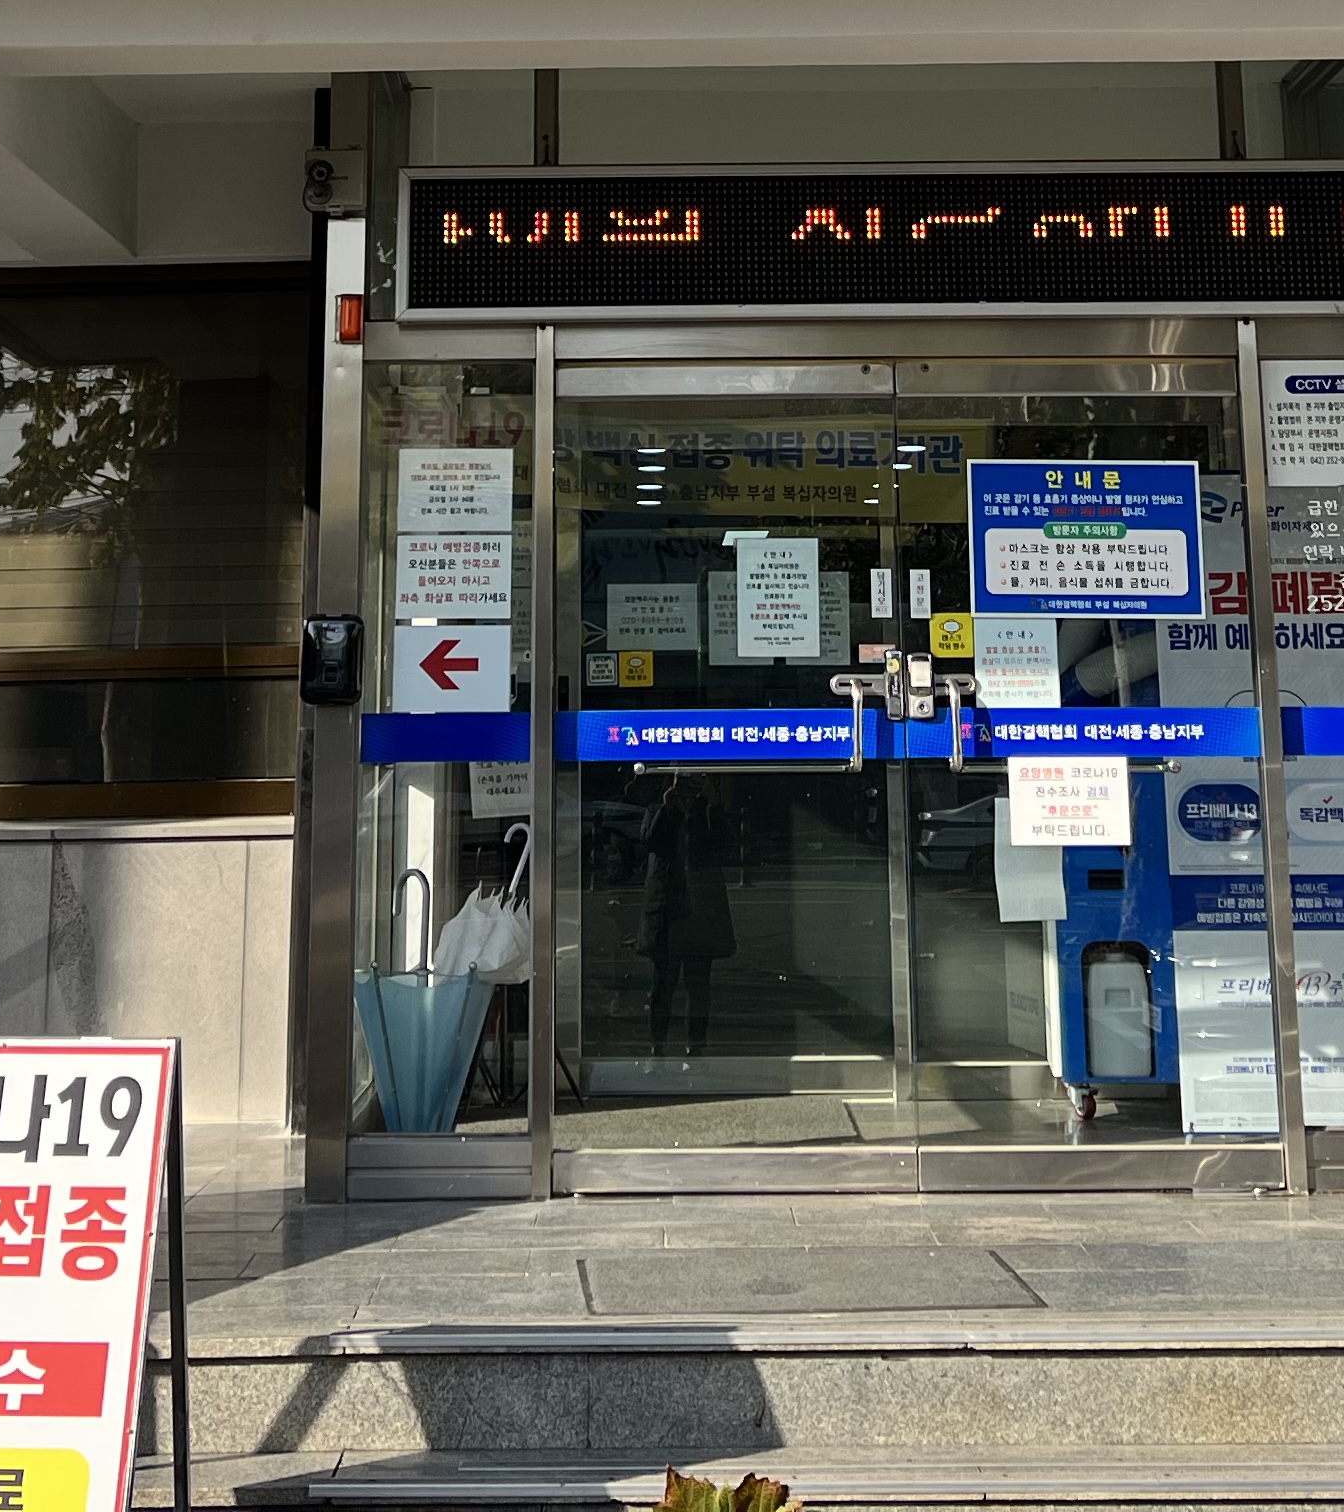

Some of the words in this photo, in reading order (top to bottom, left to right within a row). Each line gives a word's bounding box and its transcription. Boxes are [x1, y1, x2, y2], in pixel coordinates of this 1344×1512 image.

[1296, 379, 1332, 390] CCTV
[667, 431, 735, 470] 접종
[743, 430, 804, 469] 위탁
[747, 484, 776, 501] 부설
[782, 483, 858, 502] 복십자의원
[1308, 500, 1338, 516] 급한
[408, 542, 437, 552] 코로나
[1009, 544, 1049, 555] 마스크는
[1303, 545, 1334, 561] 연락
[462, 559, 500, 569] 안쪽으로
[1010, 560, 1030, 572] 진료
[418, 576, 456, 586] 들어오지
[462, 576, 490, 586] 마시고
[400, 593, 419, 604] 좌측
[425, 593, 454, 604] 화살표
[1167, 623, 1218, 650] 함께
[642, 727, 724, 743] 대한결핵협회
[731, 727, 851, 743] 대전·세종·충남지부
[995, 724, 1077, 740] 대한결핵협회
[1085, 724, 1204, 740] 대전·세종·충남지부
[1071, 768, 1118, 779] 코로나19
[1032, 825, 1110, 837] 부탁드립니다.
